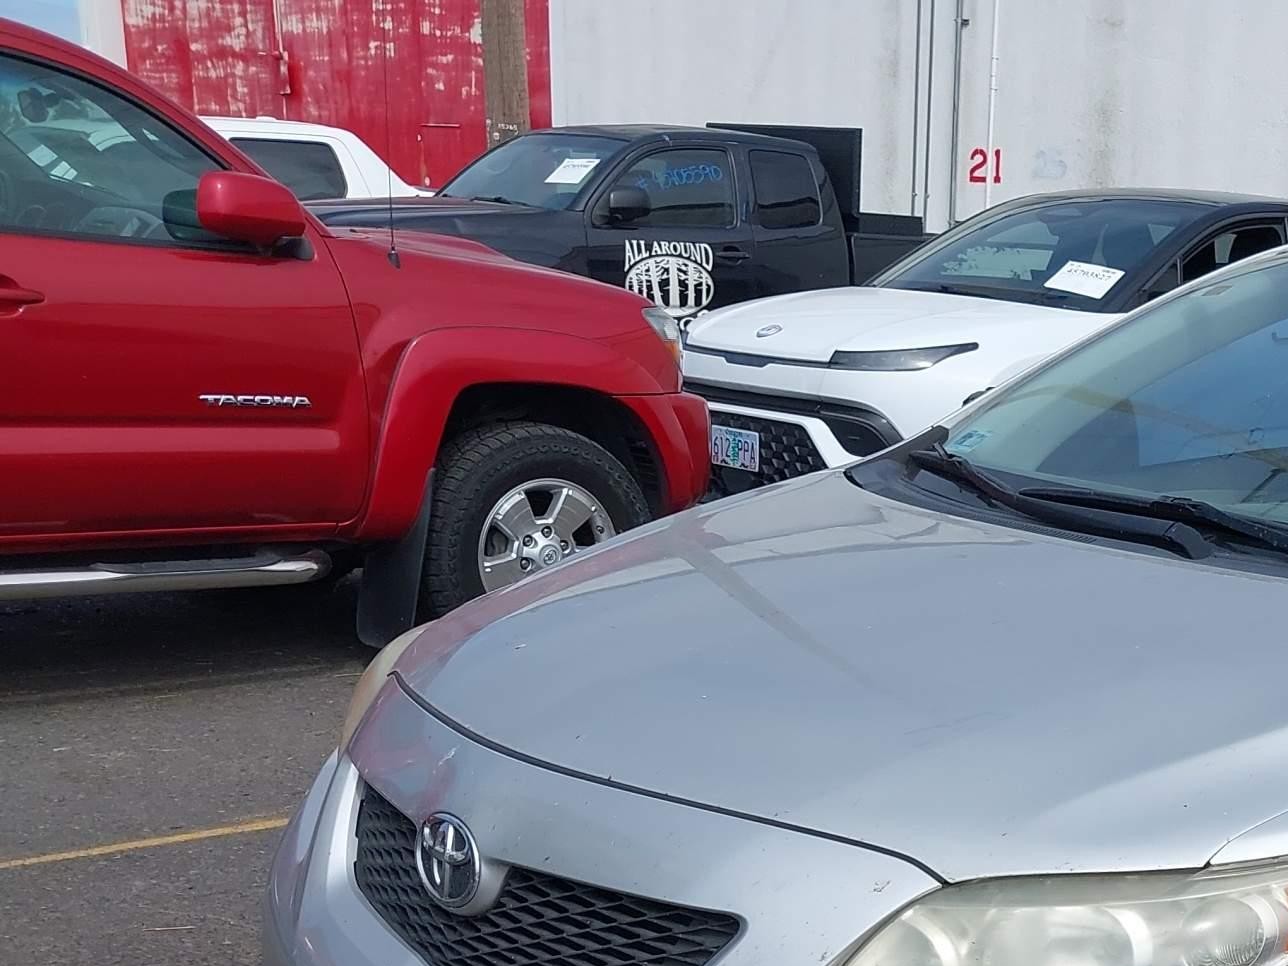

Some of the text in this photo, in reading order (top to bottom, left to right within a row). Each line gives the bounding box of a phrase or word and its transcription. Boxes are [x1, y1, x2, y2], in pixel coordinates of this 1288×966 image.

[969, 148, 1001, 184] 21
[624, 239, 714, 273] ALL AROUND
[199, 394, 313, 408] TACOMA
[713, 436, 756, 464] 612 PPA
